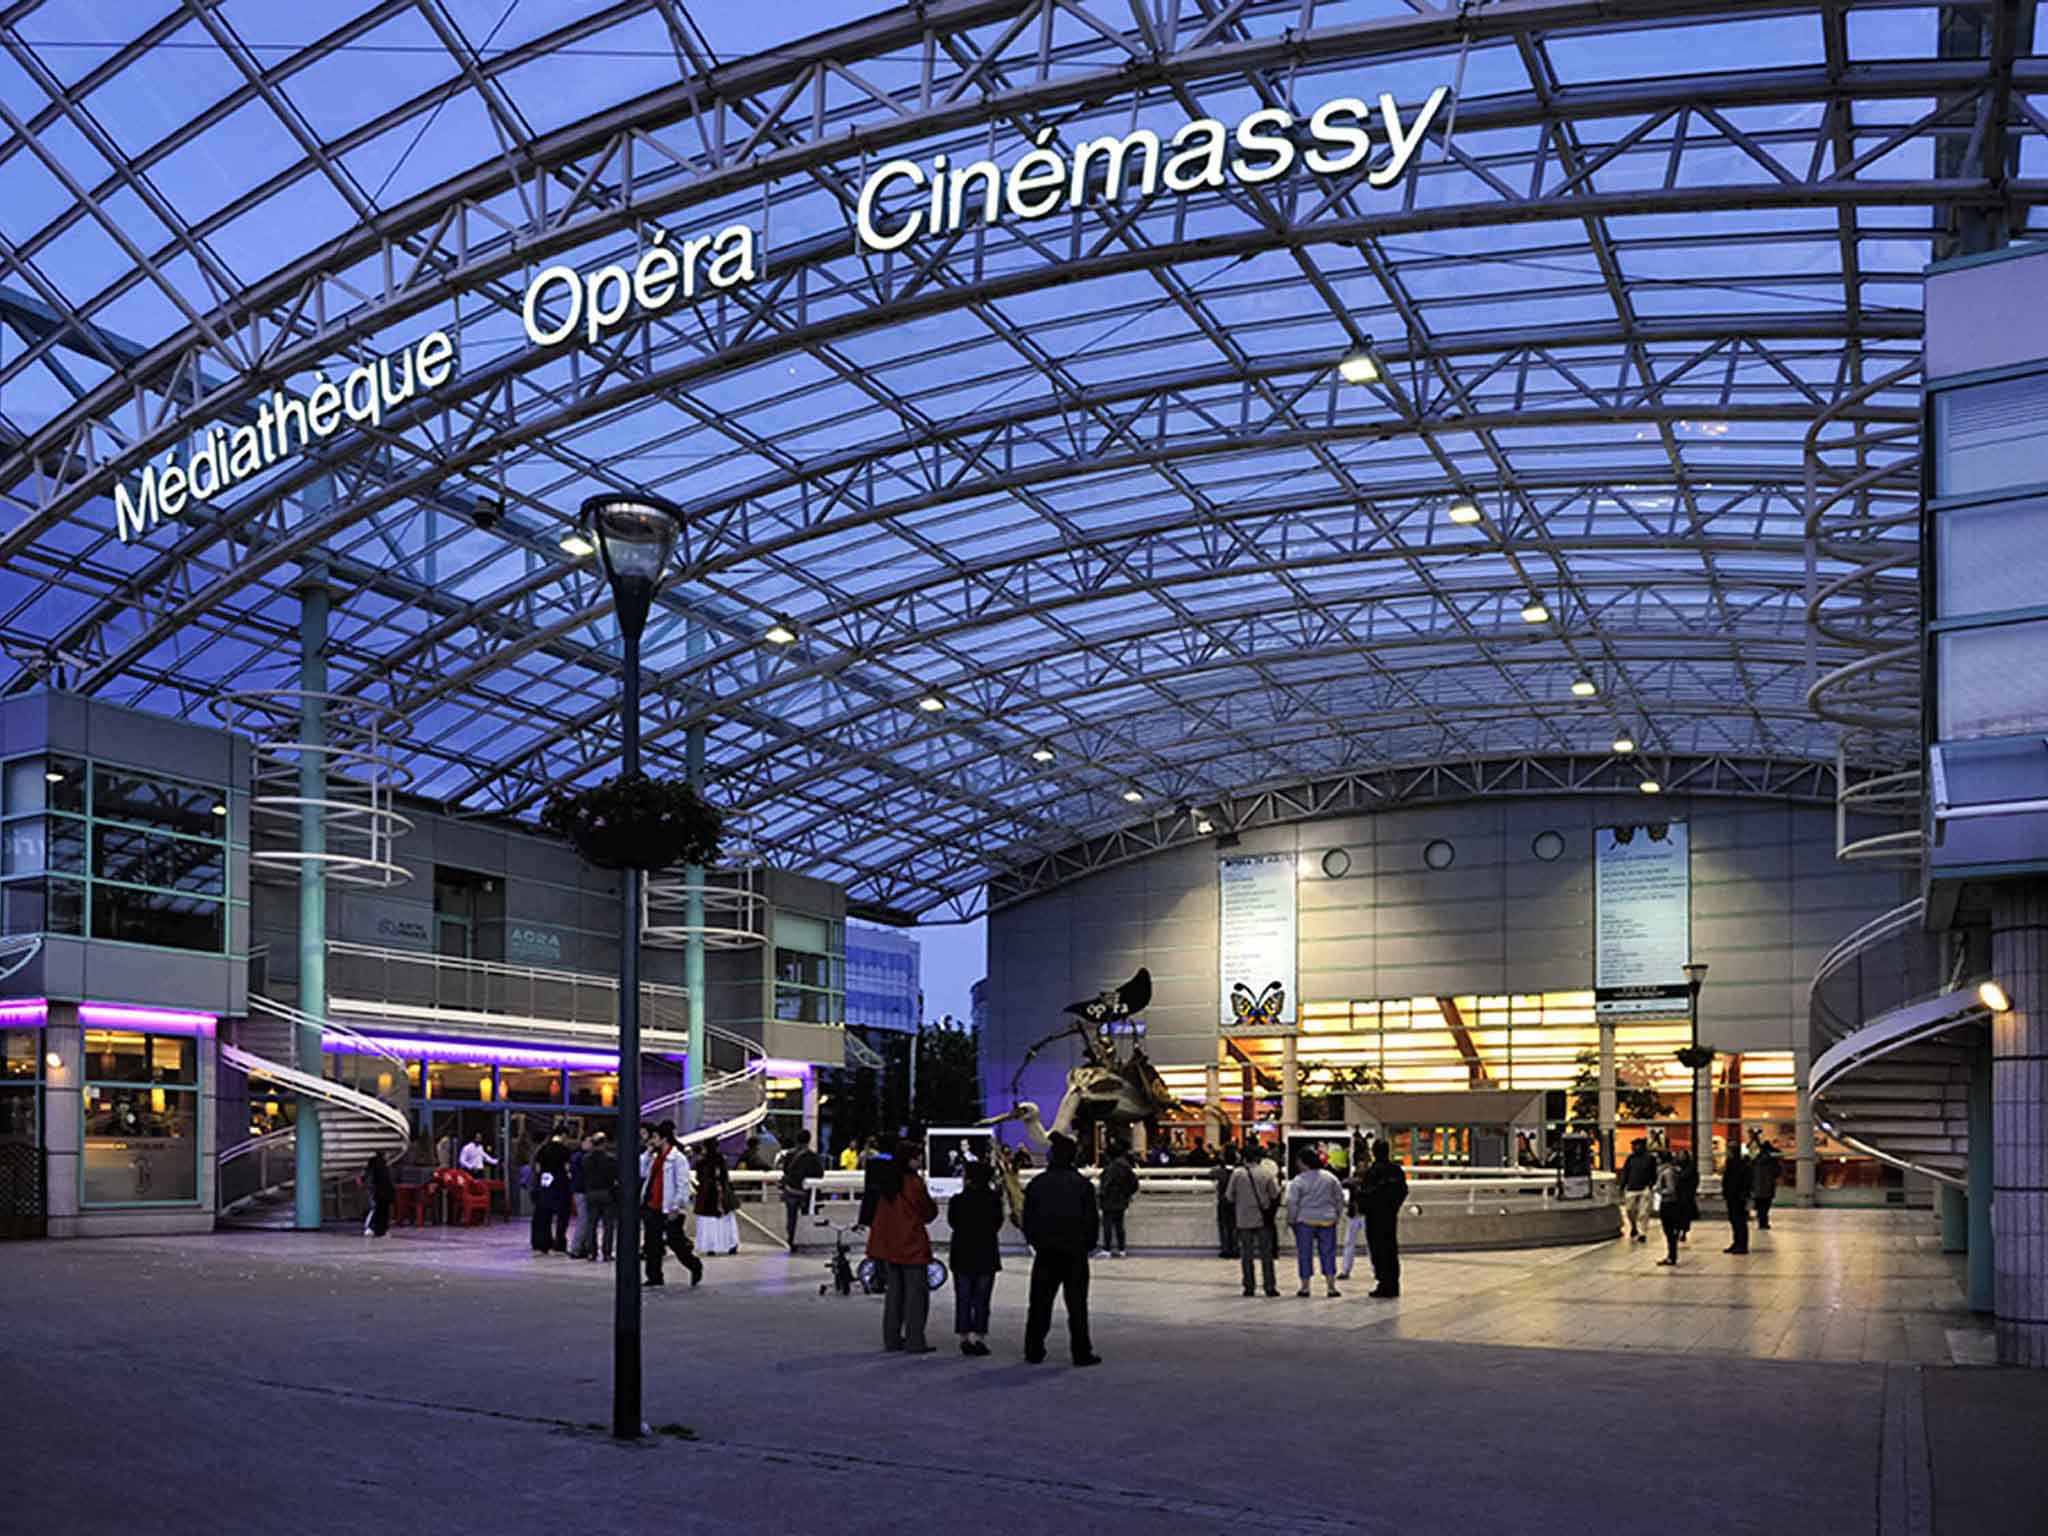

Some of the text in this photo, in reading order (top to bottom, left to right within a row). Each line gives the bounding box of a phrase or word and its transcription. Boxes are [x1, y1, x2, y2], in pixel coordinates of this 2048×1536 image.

[112, 86, 1451, 542] Médiathèque Opéra Cinémassy
